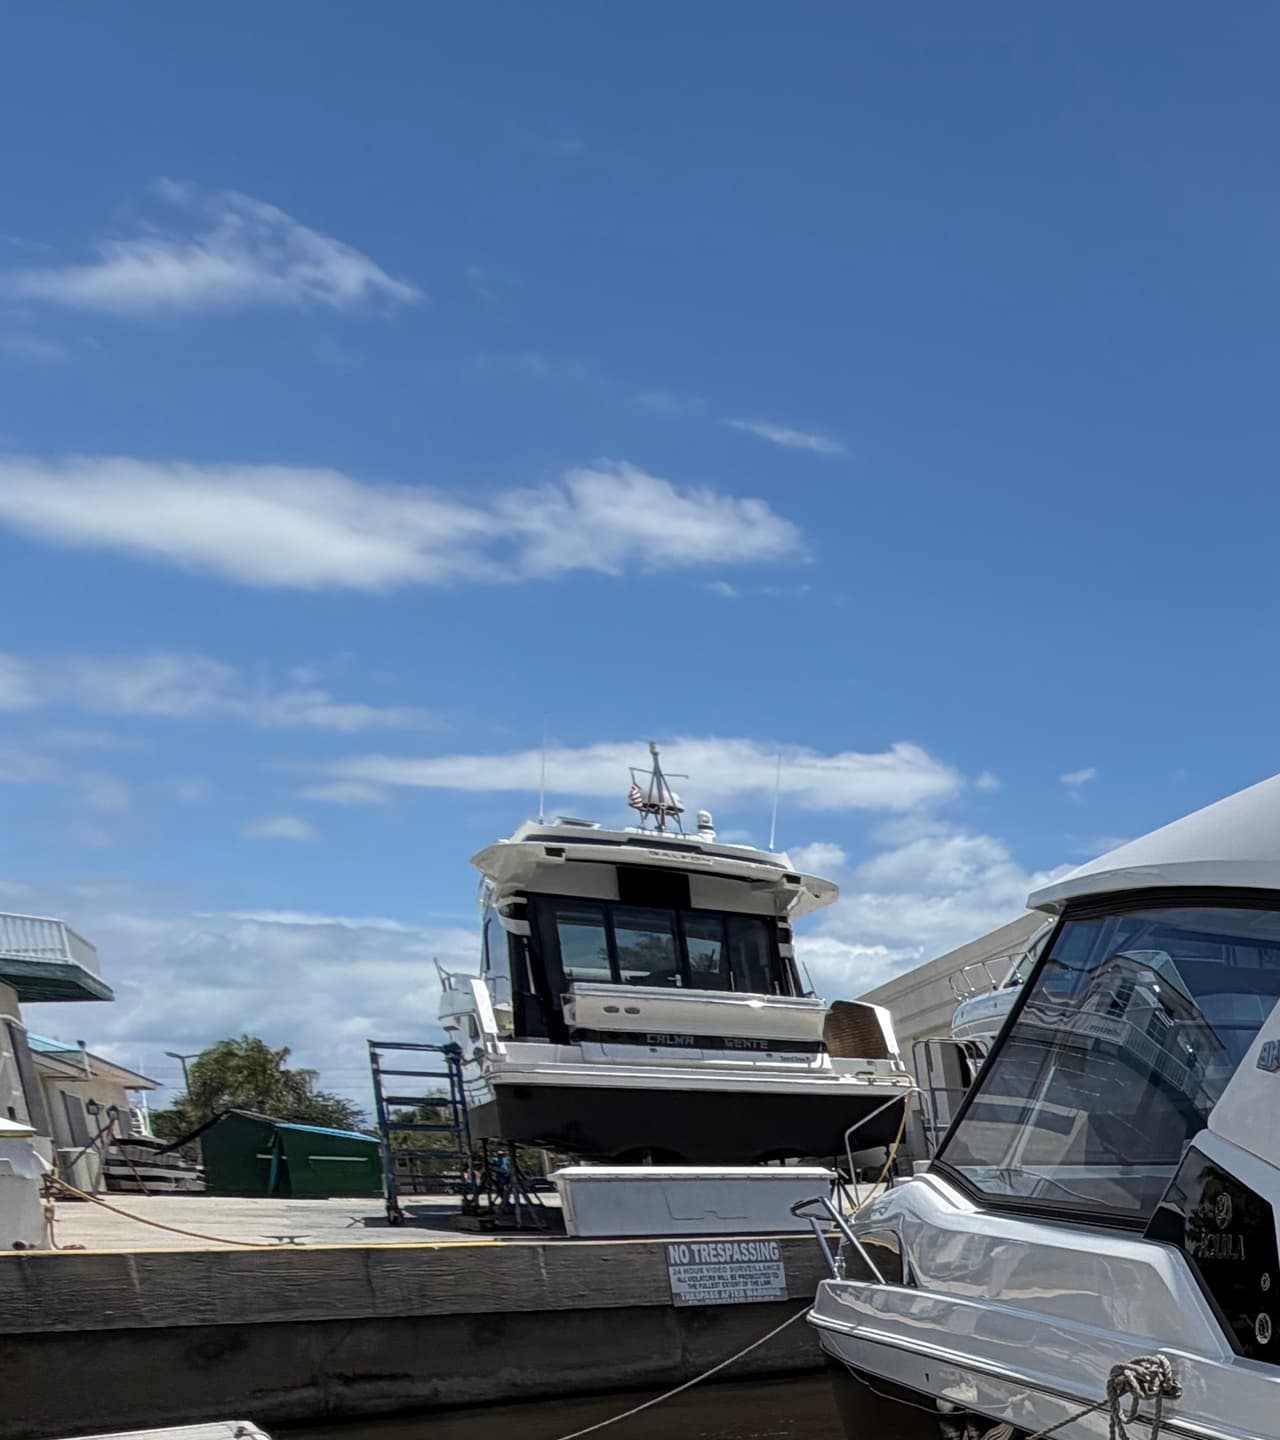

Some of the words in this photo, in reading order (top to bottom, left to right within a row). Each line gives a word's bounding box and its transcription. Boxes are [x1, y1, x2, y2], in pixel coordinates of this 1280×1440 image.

[668, 1244, 690, 1264] NO
[690, 1242, 779, 1263] TRESPASSING
[729, 1264, 780, 1273] SURVEILLANCE
